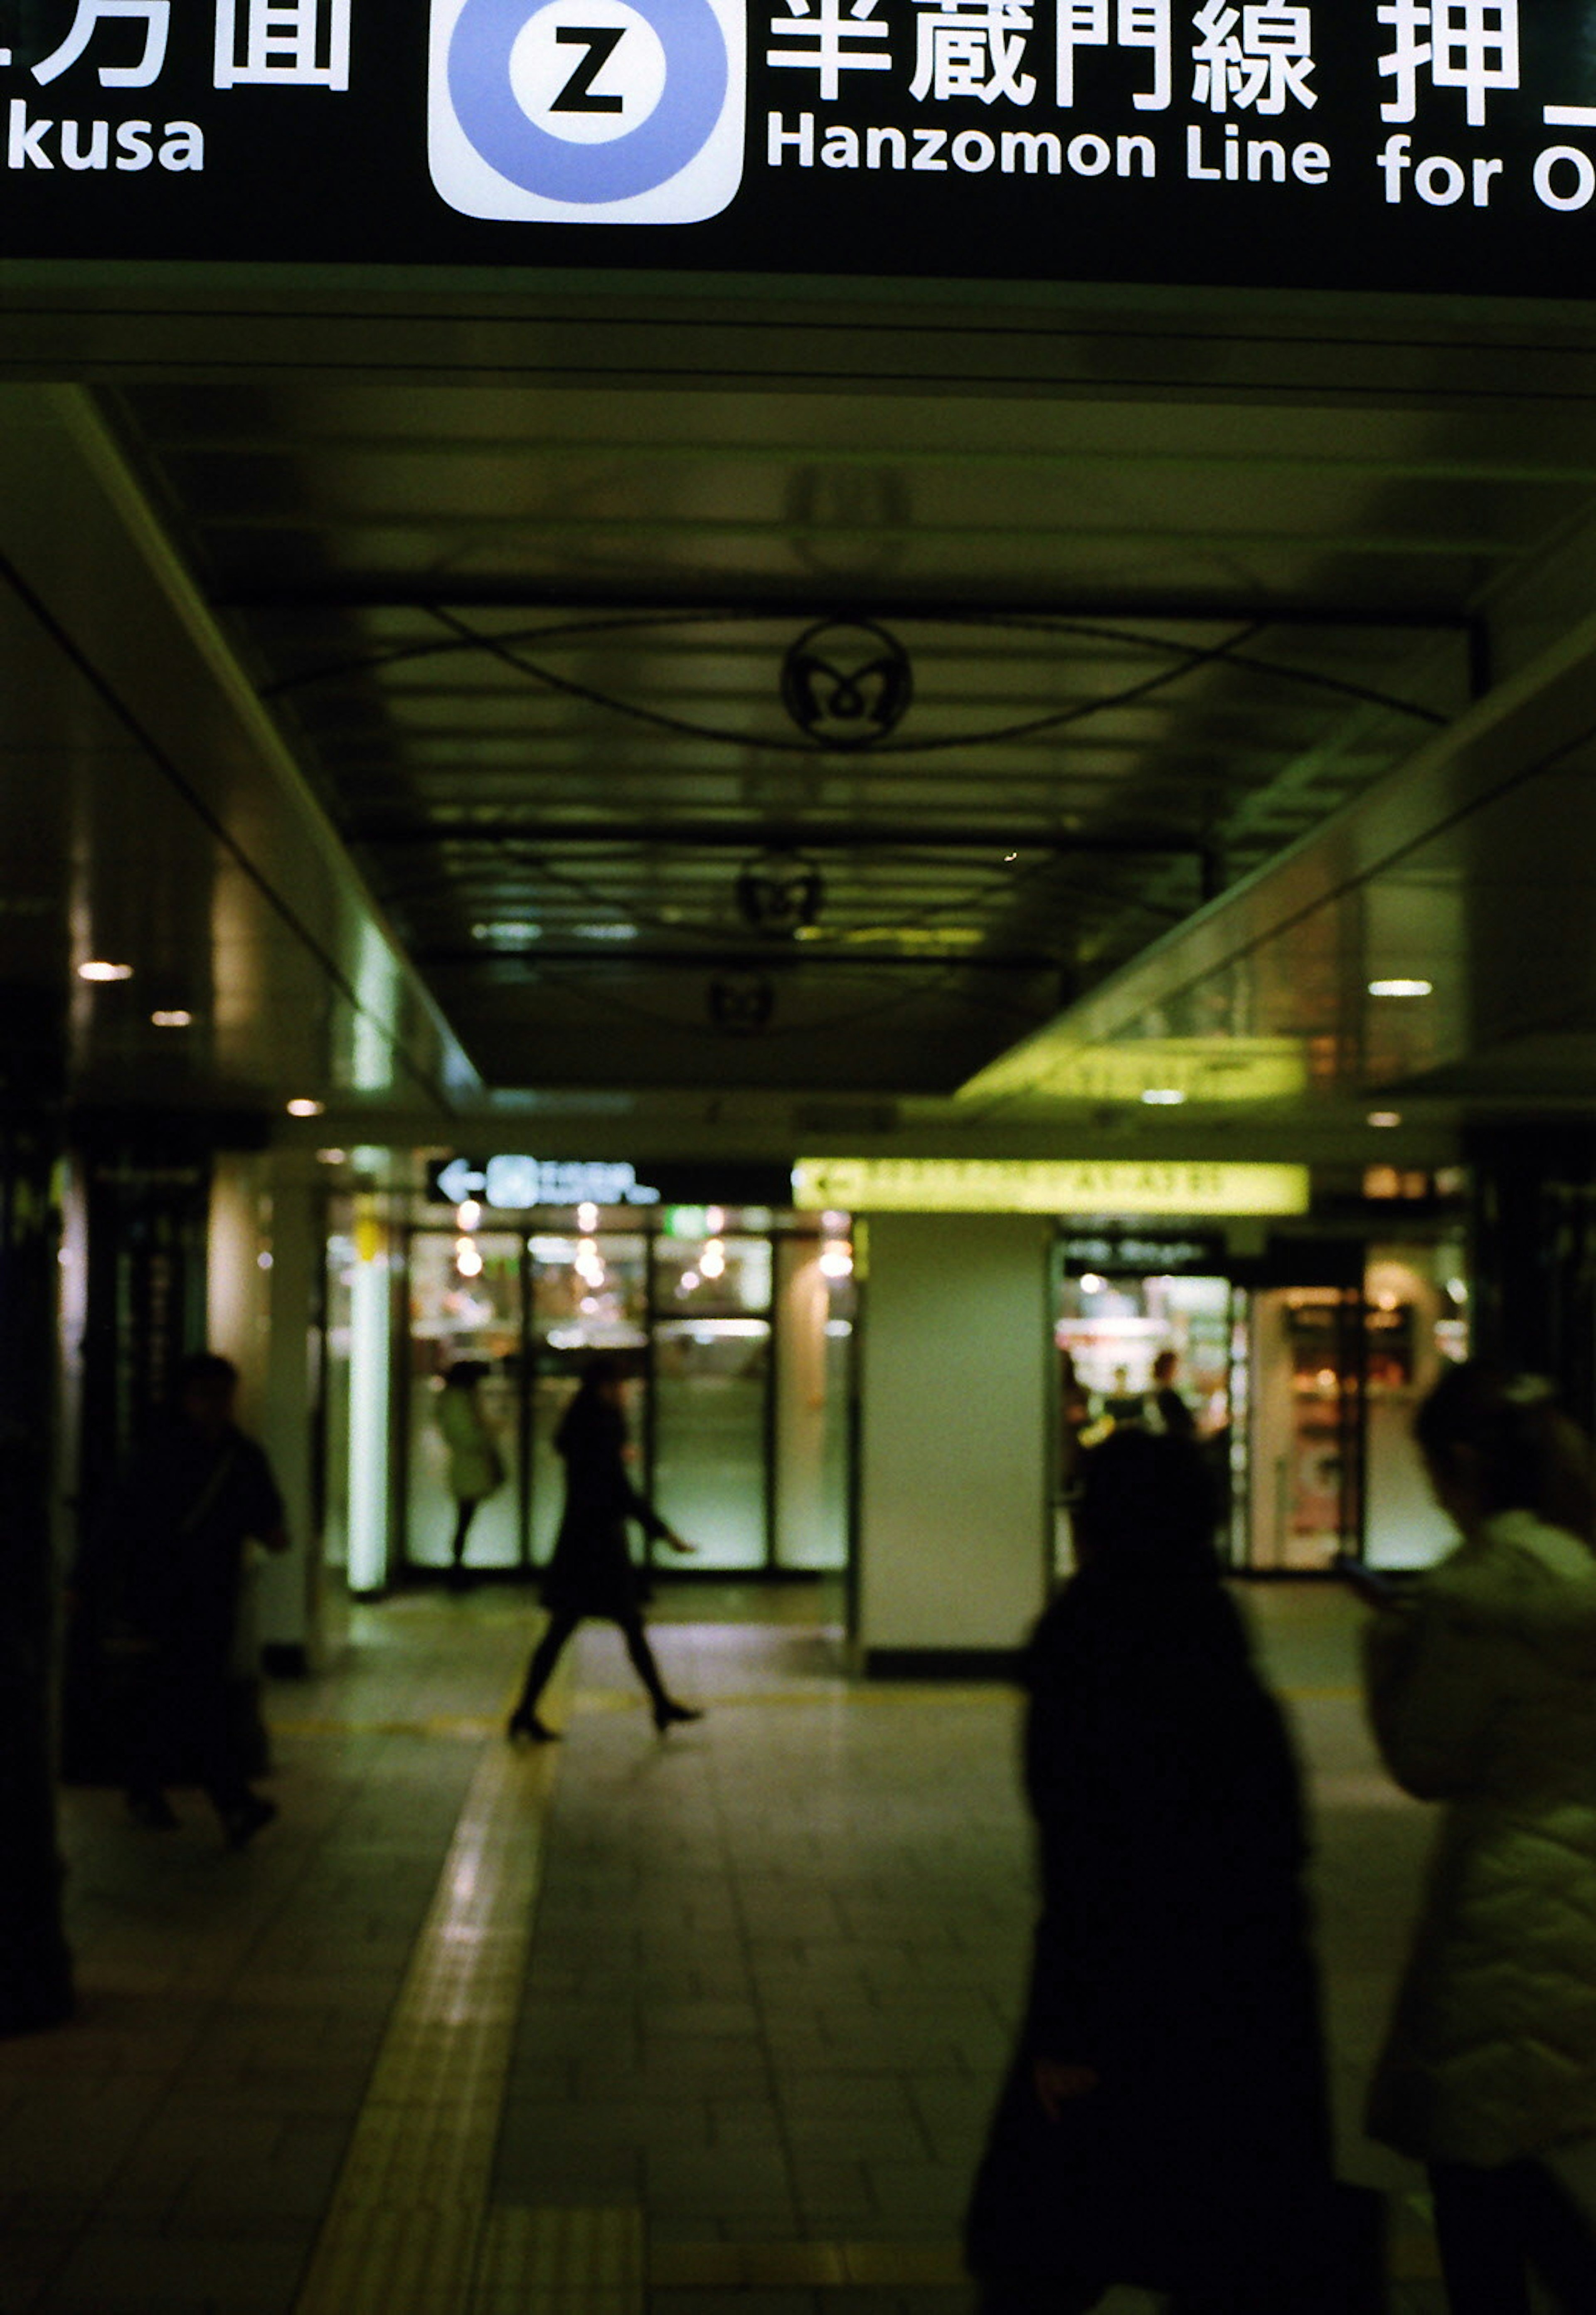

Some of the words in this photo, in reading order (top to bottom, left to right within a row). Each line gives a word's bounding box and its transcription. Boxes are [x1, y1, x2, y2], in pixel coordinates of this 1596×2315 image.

[0, 0, 350, 91] 方面
[549, 27, 627, 113] Z
[766, 0, 1318, 115] 半蔵門線
[1377, 0, 1596, 127] 押
[8, 99, 204, 171] kusa
[768, 111, 1155, 177] Hanzomon
[1187, 124, 1330, 184] Line
[1377, 134, 1503, 207] for
